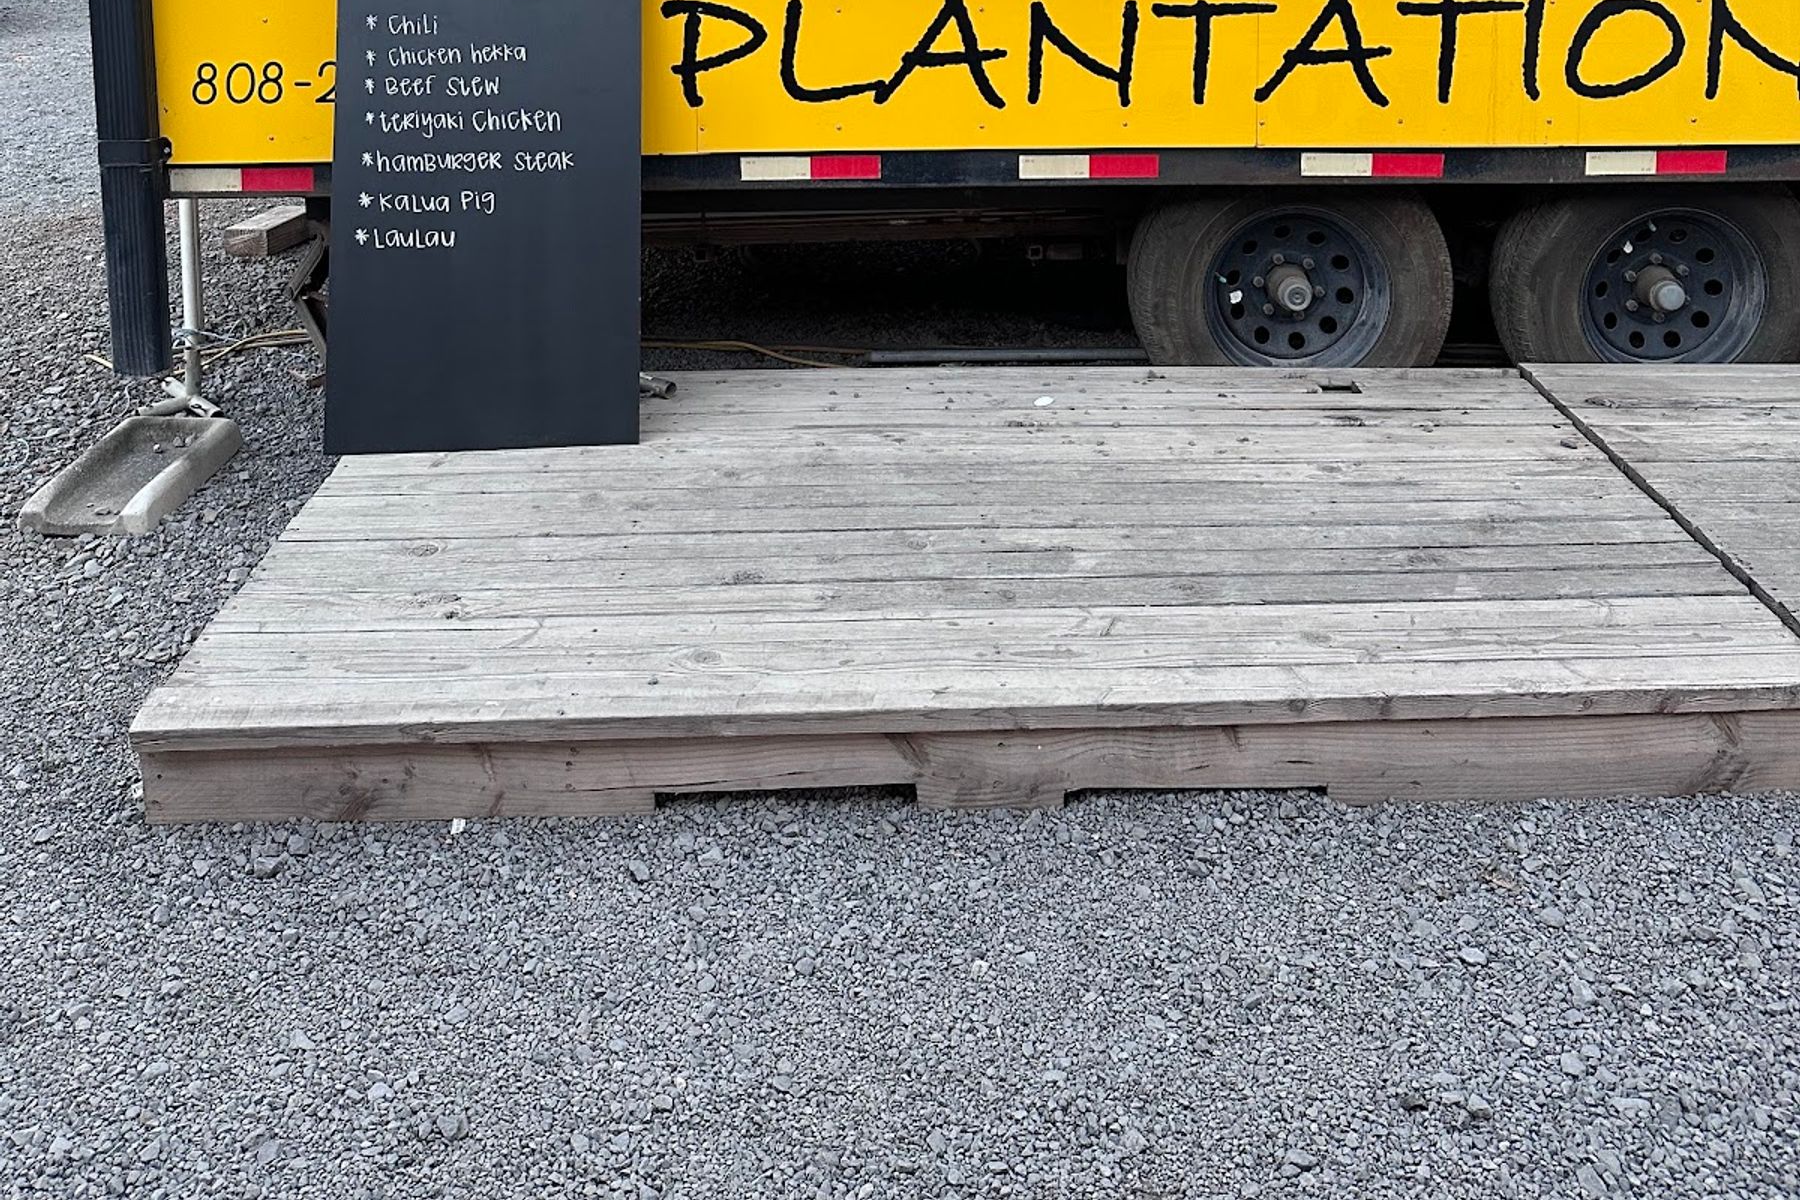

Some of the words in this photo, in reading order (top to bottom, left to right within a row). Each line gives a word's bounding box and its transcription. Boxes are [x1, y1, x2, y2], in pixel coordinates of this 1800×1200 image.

[471, 44, 526, 63] hekka
[385, 75, 436, 96] Beef
[461, 191, 494, 213] Pig
